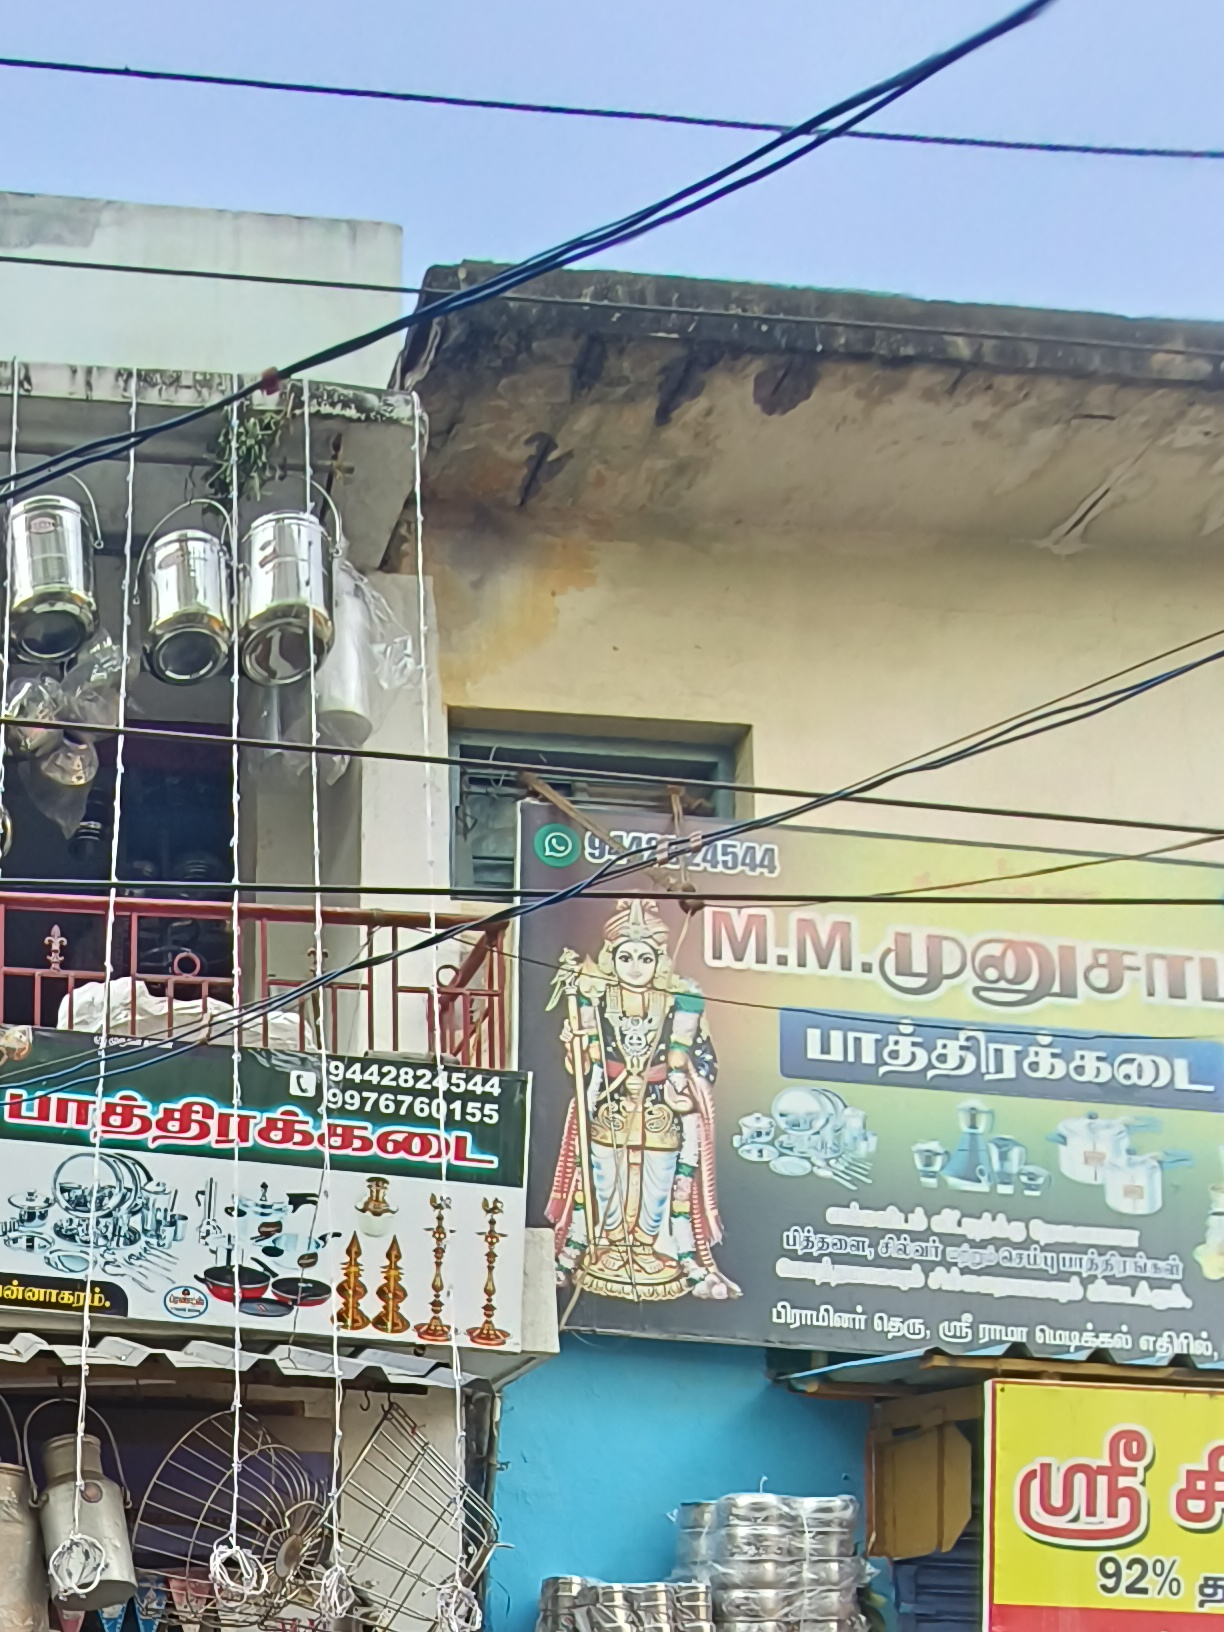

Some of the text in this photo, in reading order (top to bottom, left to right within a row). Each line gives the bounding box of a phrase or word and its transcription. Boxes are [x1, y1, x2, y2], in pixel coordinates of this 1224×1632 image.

[806, 1016, 1215, 1093] பாத்திரக்கடை
[328, 1060, 502, 1097] 9442824544
[328, 1089, 500, 1125] 9976760155
[5, 1089, 497, 1167] பாத்திரக்கடை
[1098, 1556, 1182, 1597] 92%
